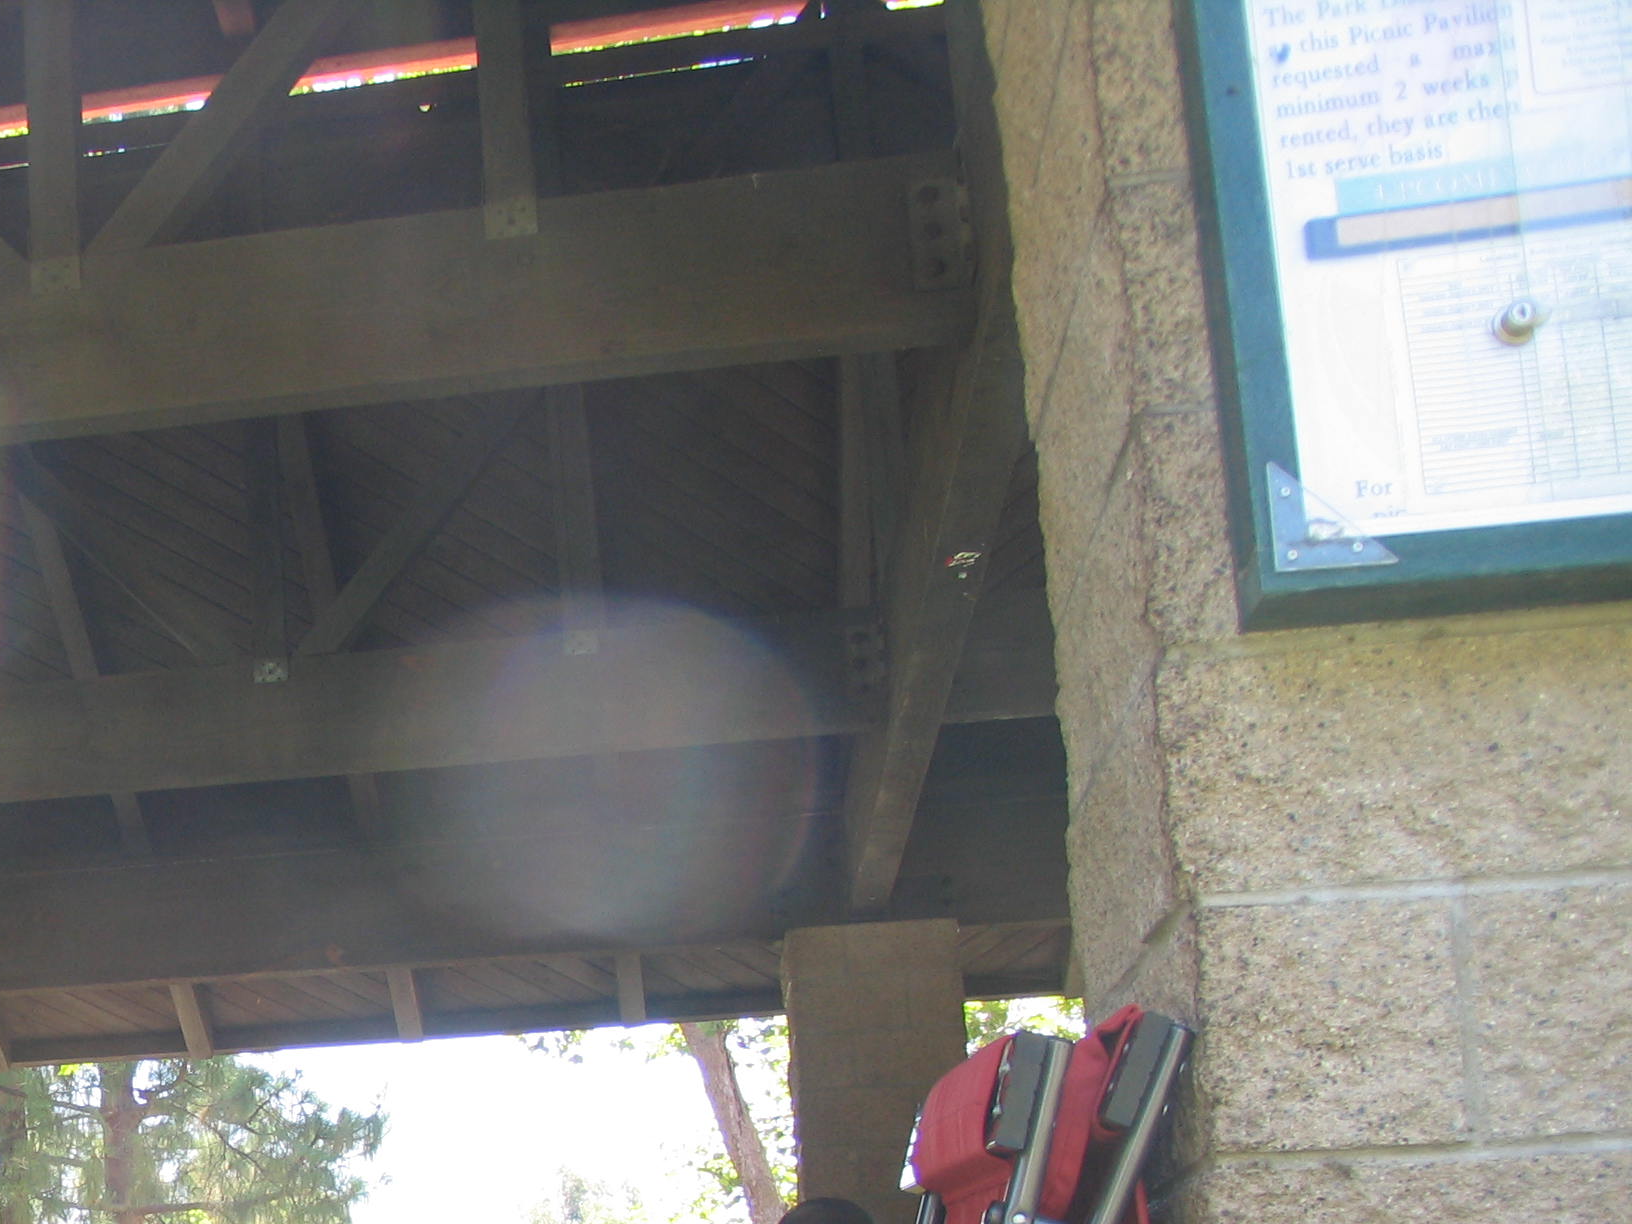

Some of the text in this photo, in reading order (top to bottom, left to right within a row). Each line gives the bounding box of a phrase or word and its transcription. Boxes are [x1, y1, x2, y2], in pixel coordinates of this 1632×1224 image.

[1263, 0, 1367, 28] The Park
[1298, 3, 1514, 52] this Picnic Pavilion
[1271, 53, 1381, 89] requested
[1409, 51, 1423, 68] a
[1274, 90, 1381, 120] minimum
[1394, 80, 1409, 101] 2
[1423, 70, 1491, 97] weeks
[1279, 98, 1522, 149] rented, they are then
[1286, 141, 1444, 180] 1st serve basis
[1355, 479, 1393, 499] For
